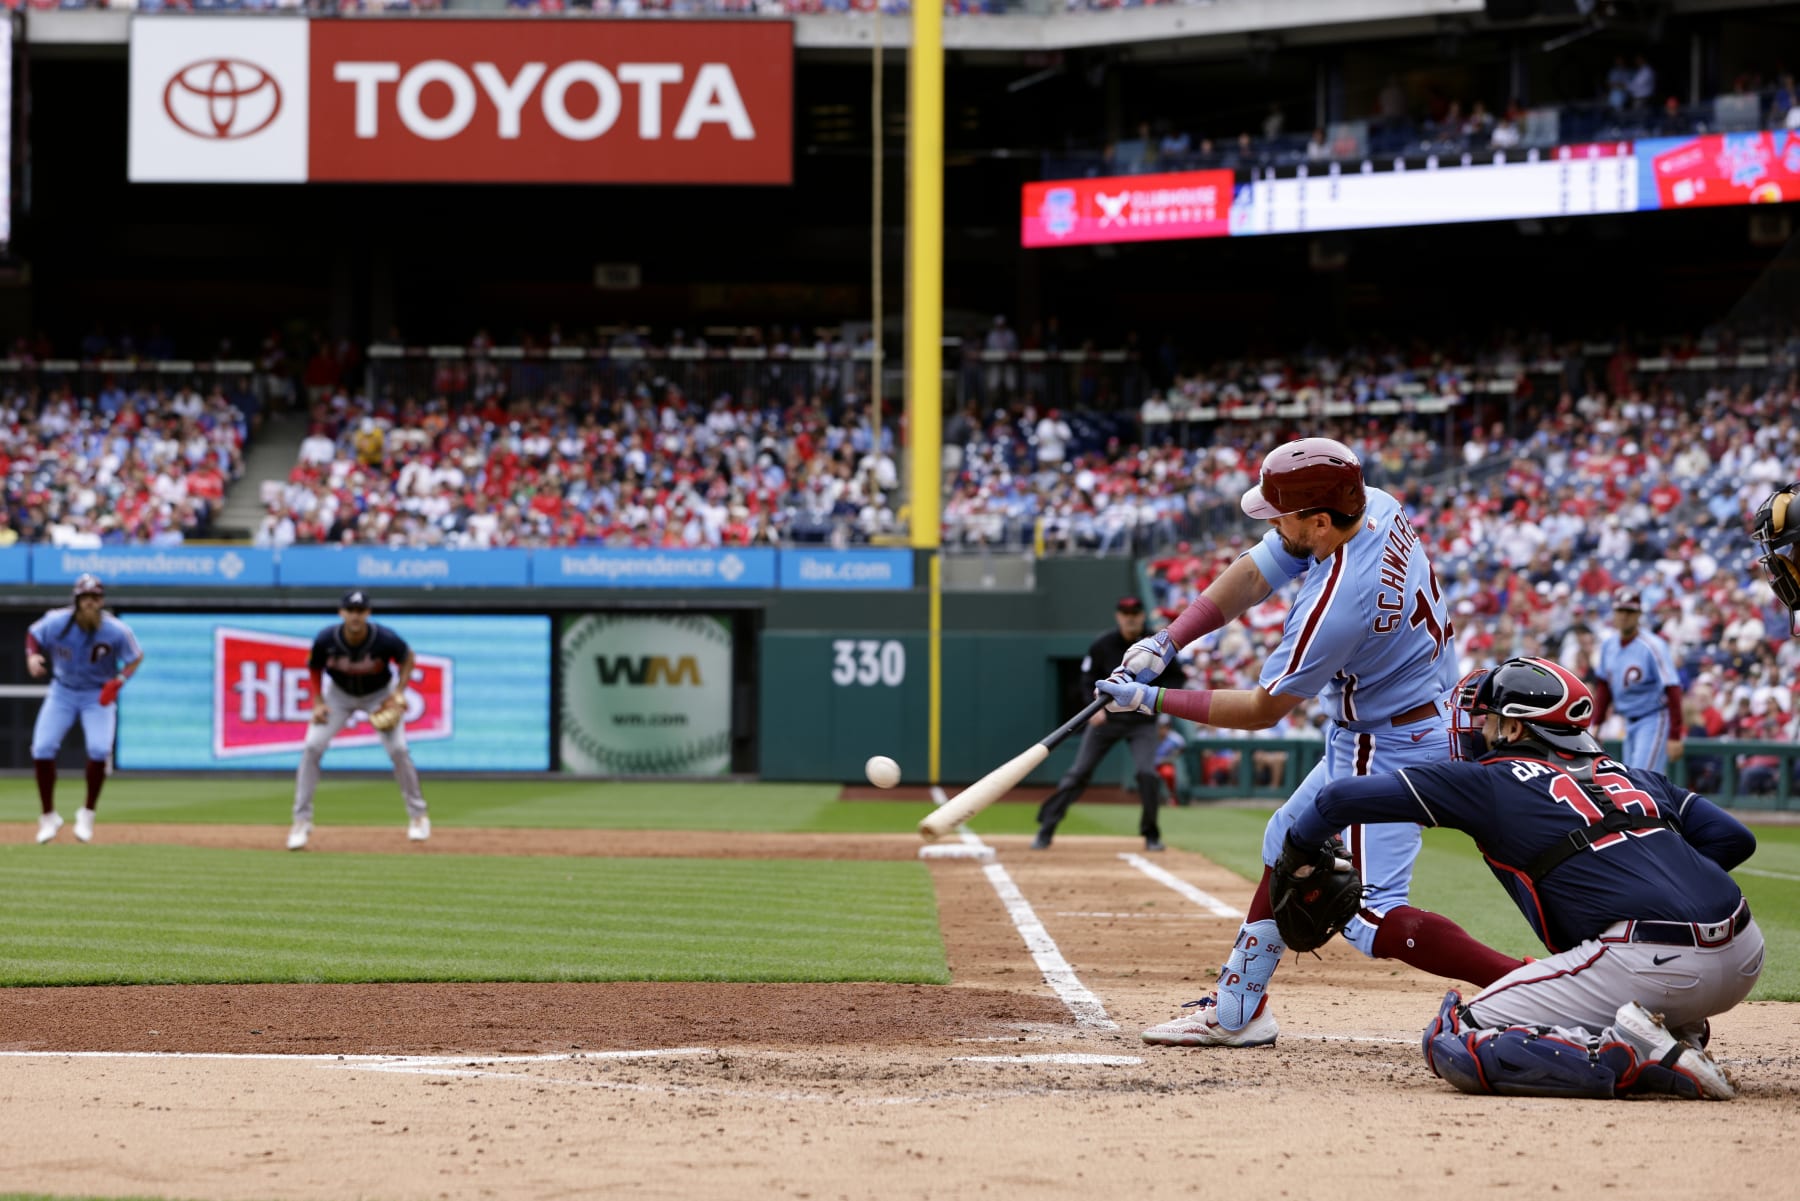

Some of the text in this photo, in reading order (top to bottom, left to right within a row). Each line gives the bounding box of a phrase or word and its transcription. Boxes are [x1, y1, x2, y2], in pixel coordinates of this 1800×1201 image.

[334, 60, 755, 140] TOYOTA
[61, 552, 215, 575] Independence
[356, 555, 449, 578] ibx.com
[561, 553, 715, 579] Independence
[799, 557, 891, 581] ibx.com
[1373, 505, 1418, 634] SCHWAR
[595, 654, 702, 687] WM
[832, 640, 905, 686] 330
[611, 711, 688, 728] wm.com
